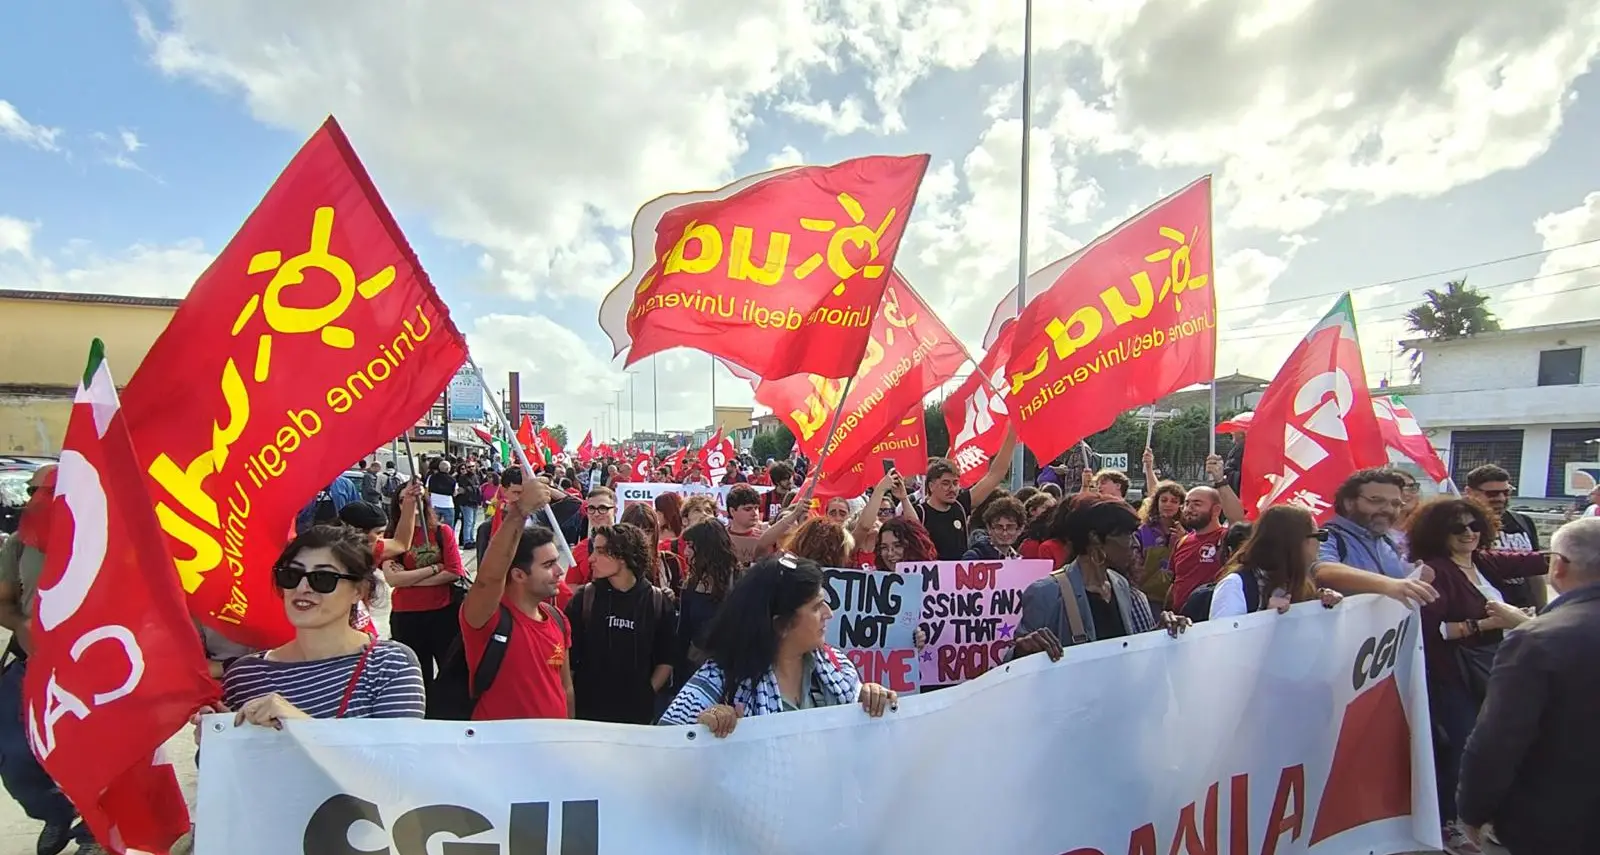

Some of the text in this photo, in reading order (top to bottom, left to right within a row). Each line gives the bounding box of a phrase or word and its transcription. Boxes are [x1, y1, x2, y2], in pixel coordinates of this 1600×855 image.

[624, 490, 653, 499] CGIL
[955, 562, 1003, 591] NOT
[605, 615, 635, 630] Tupac
[839, 614, 895, 649] NOT
[950, 618, 1002, 645] THAT
